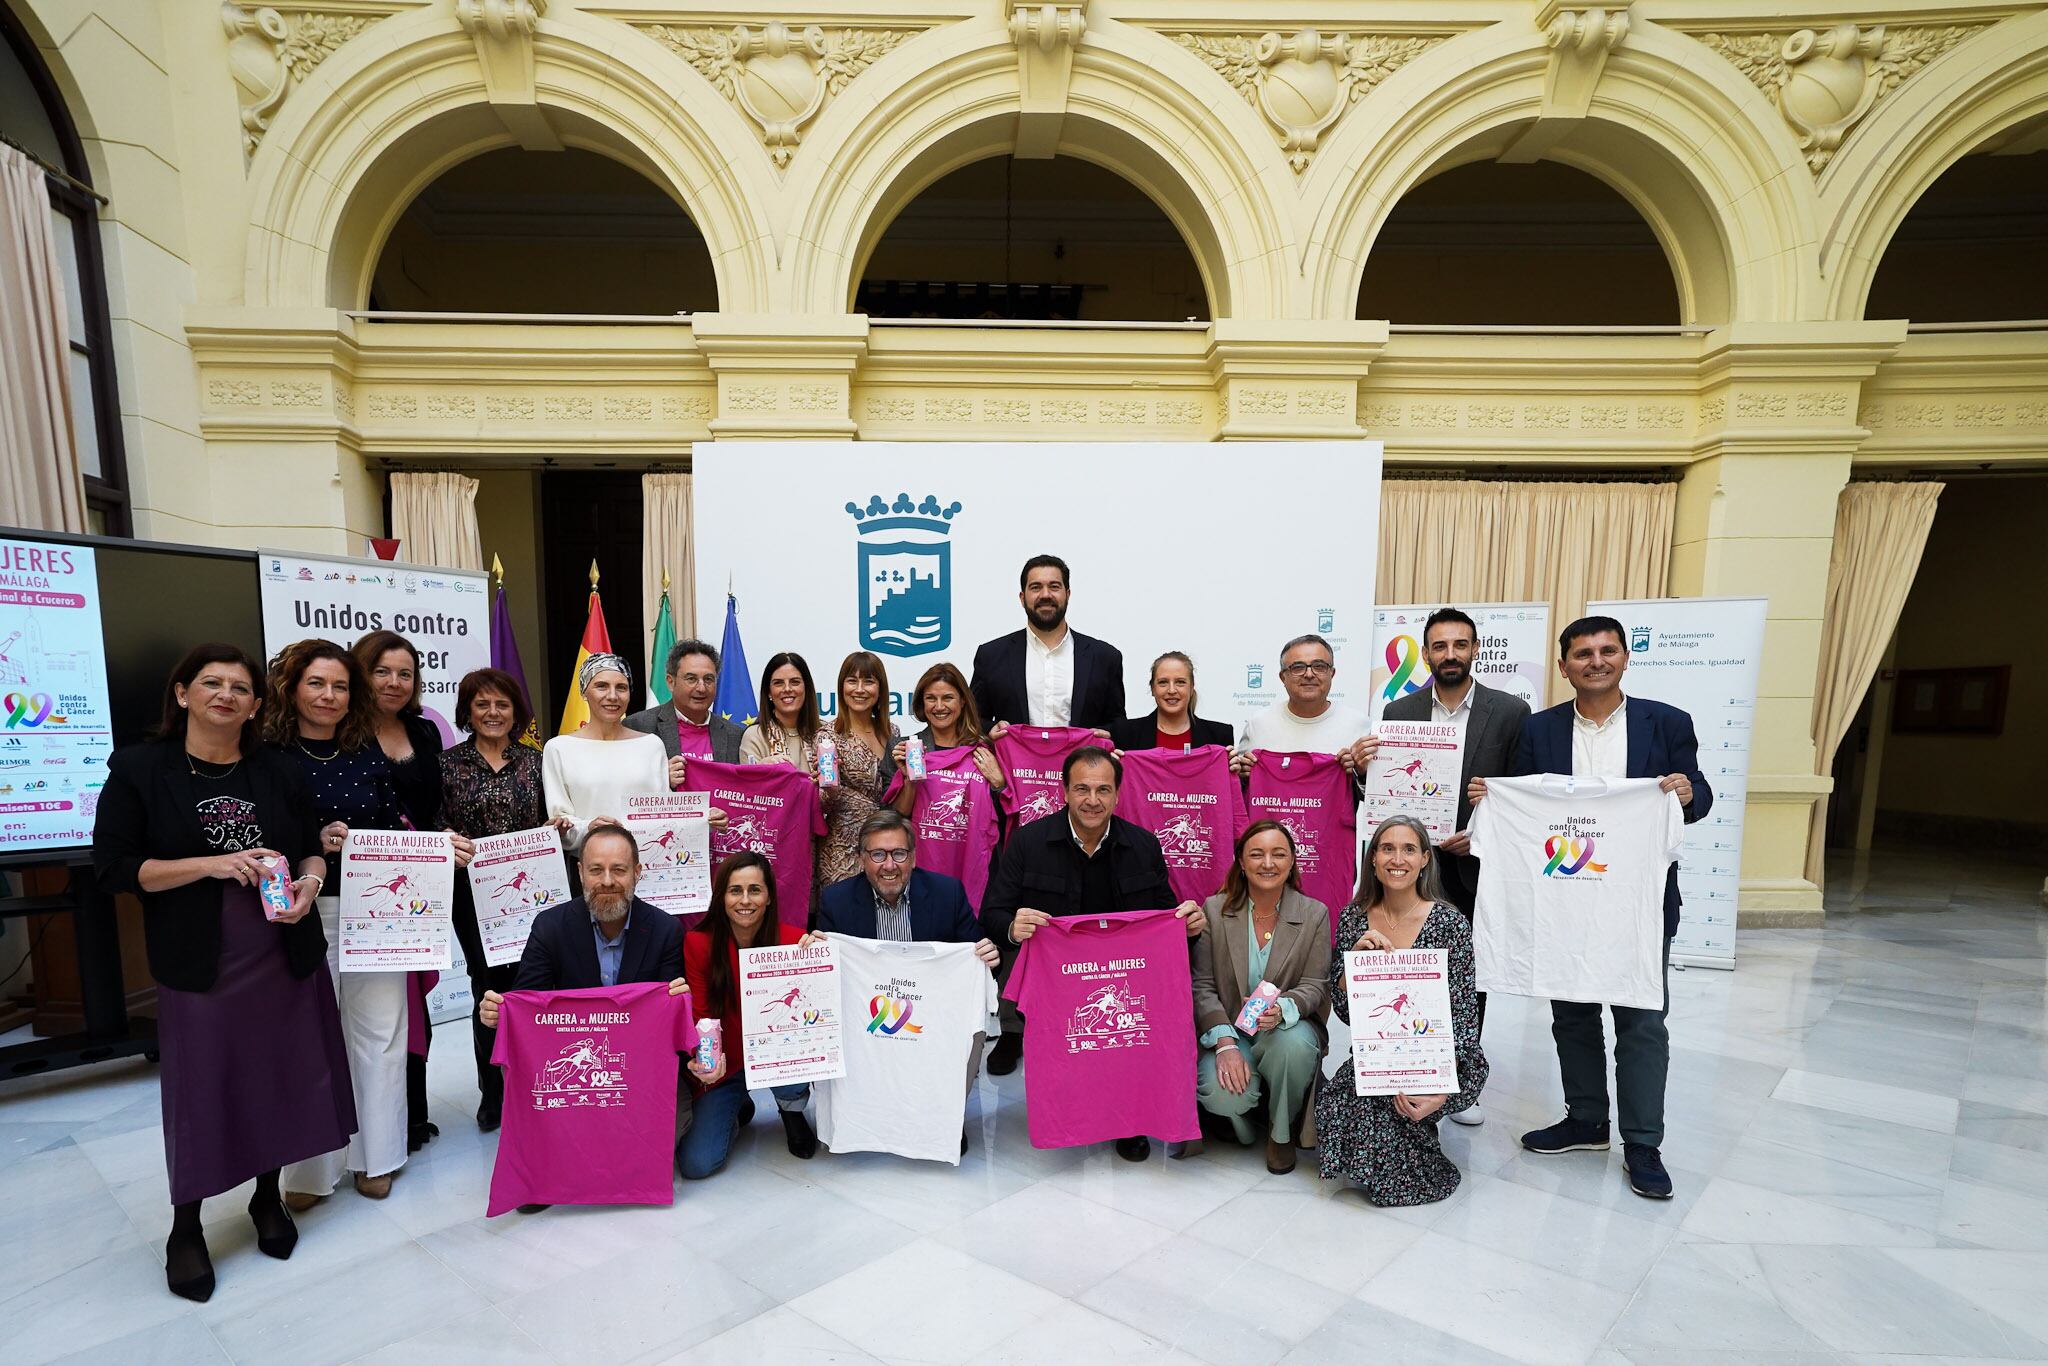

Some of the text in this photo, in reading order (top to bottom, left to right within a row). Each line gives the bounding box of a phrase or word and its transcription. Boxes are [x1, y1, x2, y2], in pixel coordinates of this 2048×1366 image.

[21, 592, 33, 603] de
[35, 593, 76, 606] Cruceros
[295, 600, 468, 636] Unidos contra
[1658, 632, 1715, 640] Ayuntamiento
[1475, 661, 1519, 674] Cáncer
[1629, 659, 1668, 667] Derechos
[1708, 658, 1746, 667] Igualdad
[1380, 725, 1456, 737] CARRERA MUJERES
[629, 795, 702, 807] CARRERA MUJERES
[713, 789, 745, 802] CARRERA
[752, 795, 784, 808] MUJERES
[1147, 792, 1178, 802] CARRERA
[1186, 794, 1218, 804] MUJERES
[1251, 797, 1281, 807] CARRERA
[1289, 797, 1322, 808] MUJERES
[39, 802, 62, 810] 10€
[1567, 816, 1597, 825] Unidos
[1549, 823, 1577, 831] contra
[513, 831, 552, 846] MUJERES
[1563, 829, 1605, 838] el Cáncer
[353, 835, 445, 848] CARRERA MUJERES
[748, 946, 831, 965] CARRERA MUJERES
[1354, 953, 1438, 967] CARRERA MUJERES
[1061, 962, 1099, 975] CARRERA
[1108, 958, 1146, 971] MUJERES
[874, 984, 899, 992] contra
[891, 978, 916, 988] Unidos
[886, 990, 923, 1001] el Cáncer
[534, 1013, 577, 1025] CARRERA
[588, 1012, 630, 1024] MUJERES
